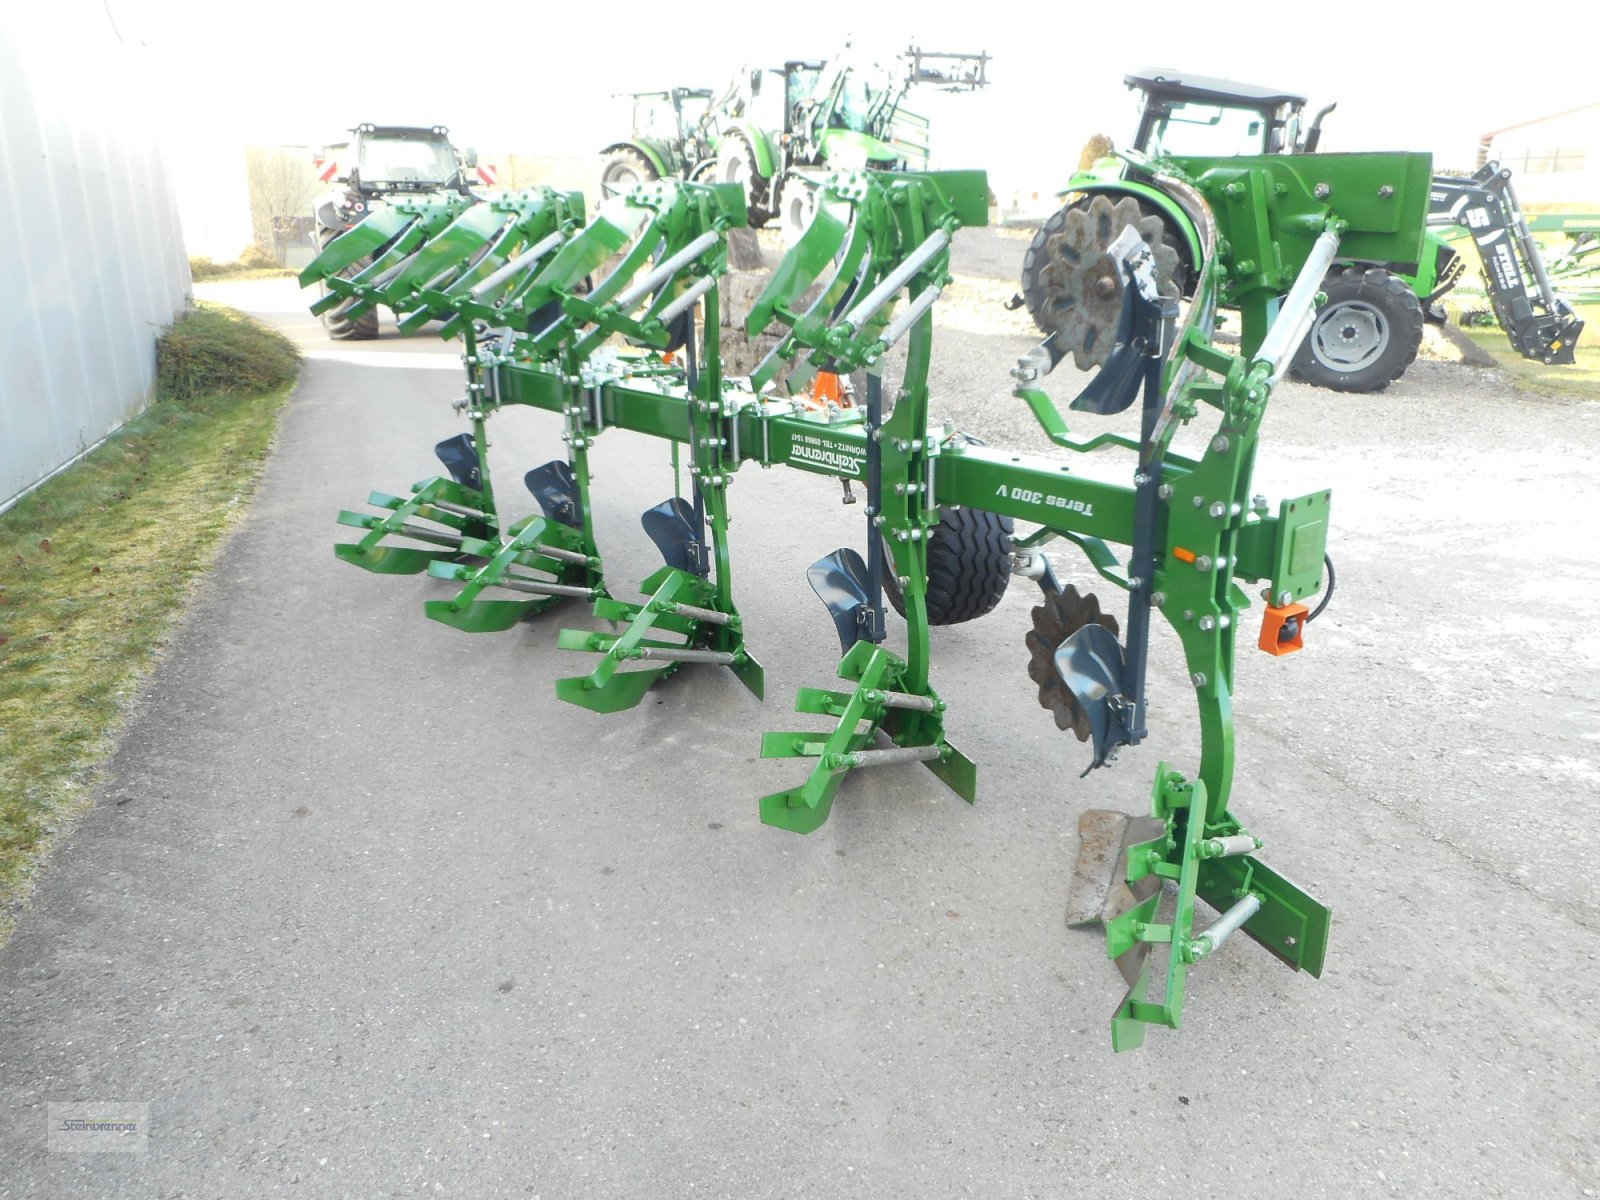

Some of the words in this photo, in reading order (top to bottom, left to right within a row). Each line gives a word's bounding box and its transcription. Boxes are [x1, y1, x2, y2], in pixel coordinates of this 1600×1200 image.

[1495, 244, 1519, 289] STOLL
[789, 444, 866, 475] Steinbrenner
[995, 484, 1008, 497] V
[1010, 488, 1043, 505] 300
[1045, 495, 1093, 517] Teres
